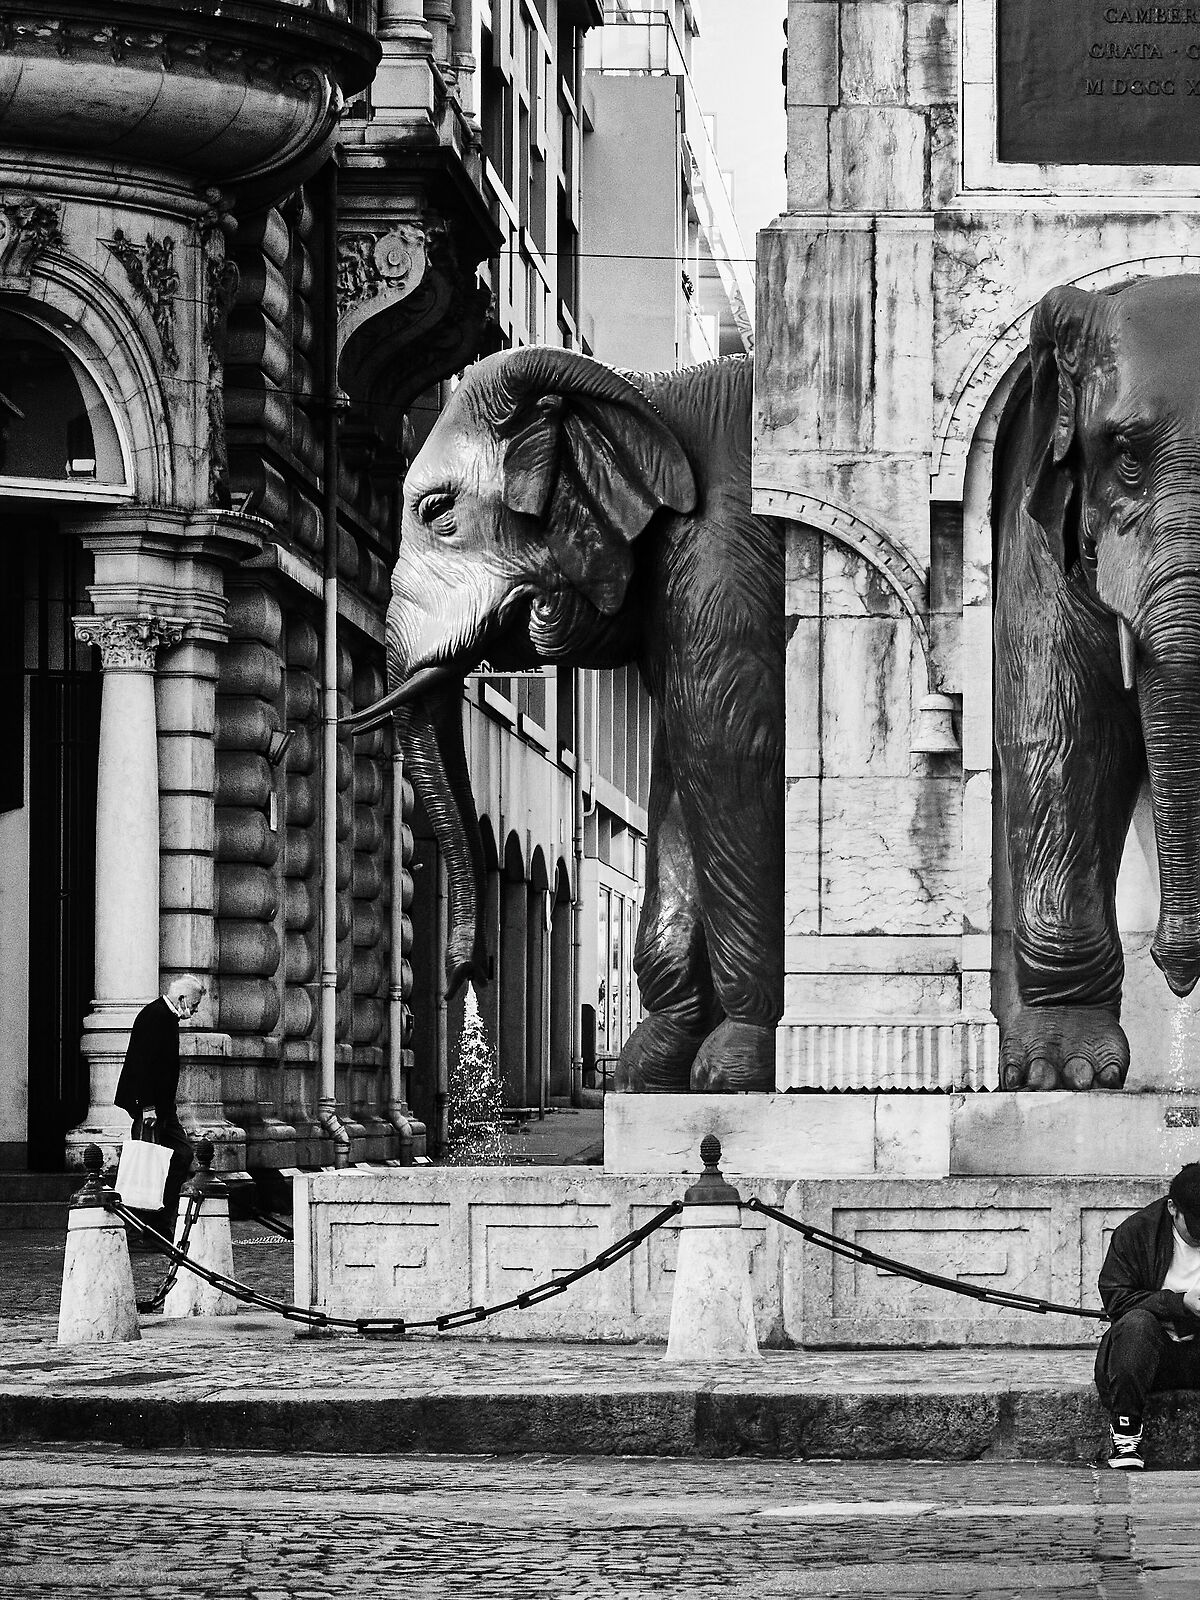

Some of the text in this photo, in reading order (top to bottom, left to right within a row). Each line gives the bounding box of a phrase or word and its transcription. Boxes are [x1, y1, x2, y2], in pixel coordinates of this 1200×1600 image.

[1088, 43, 1164, 60] GRATA
[1085, 79, 1104, 96] M
[1111, 79, 1176, 96] DCCC
